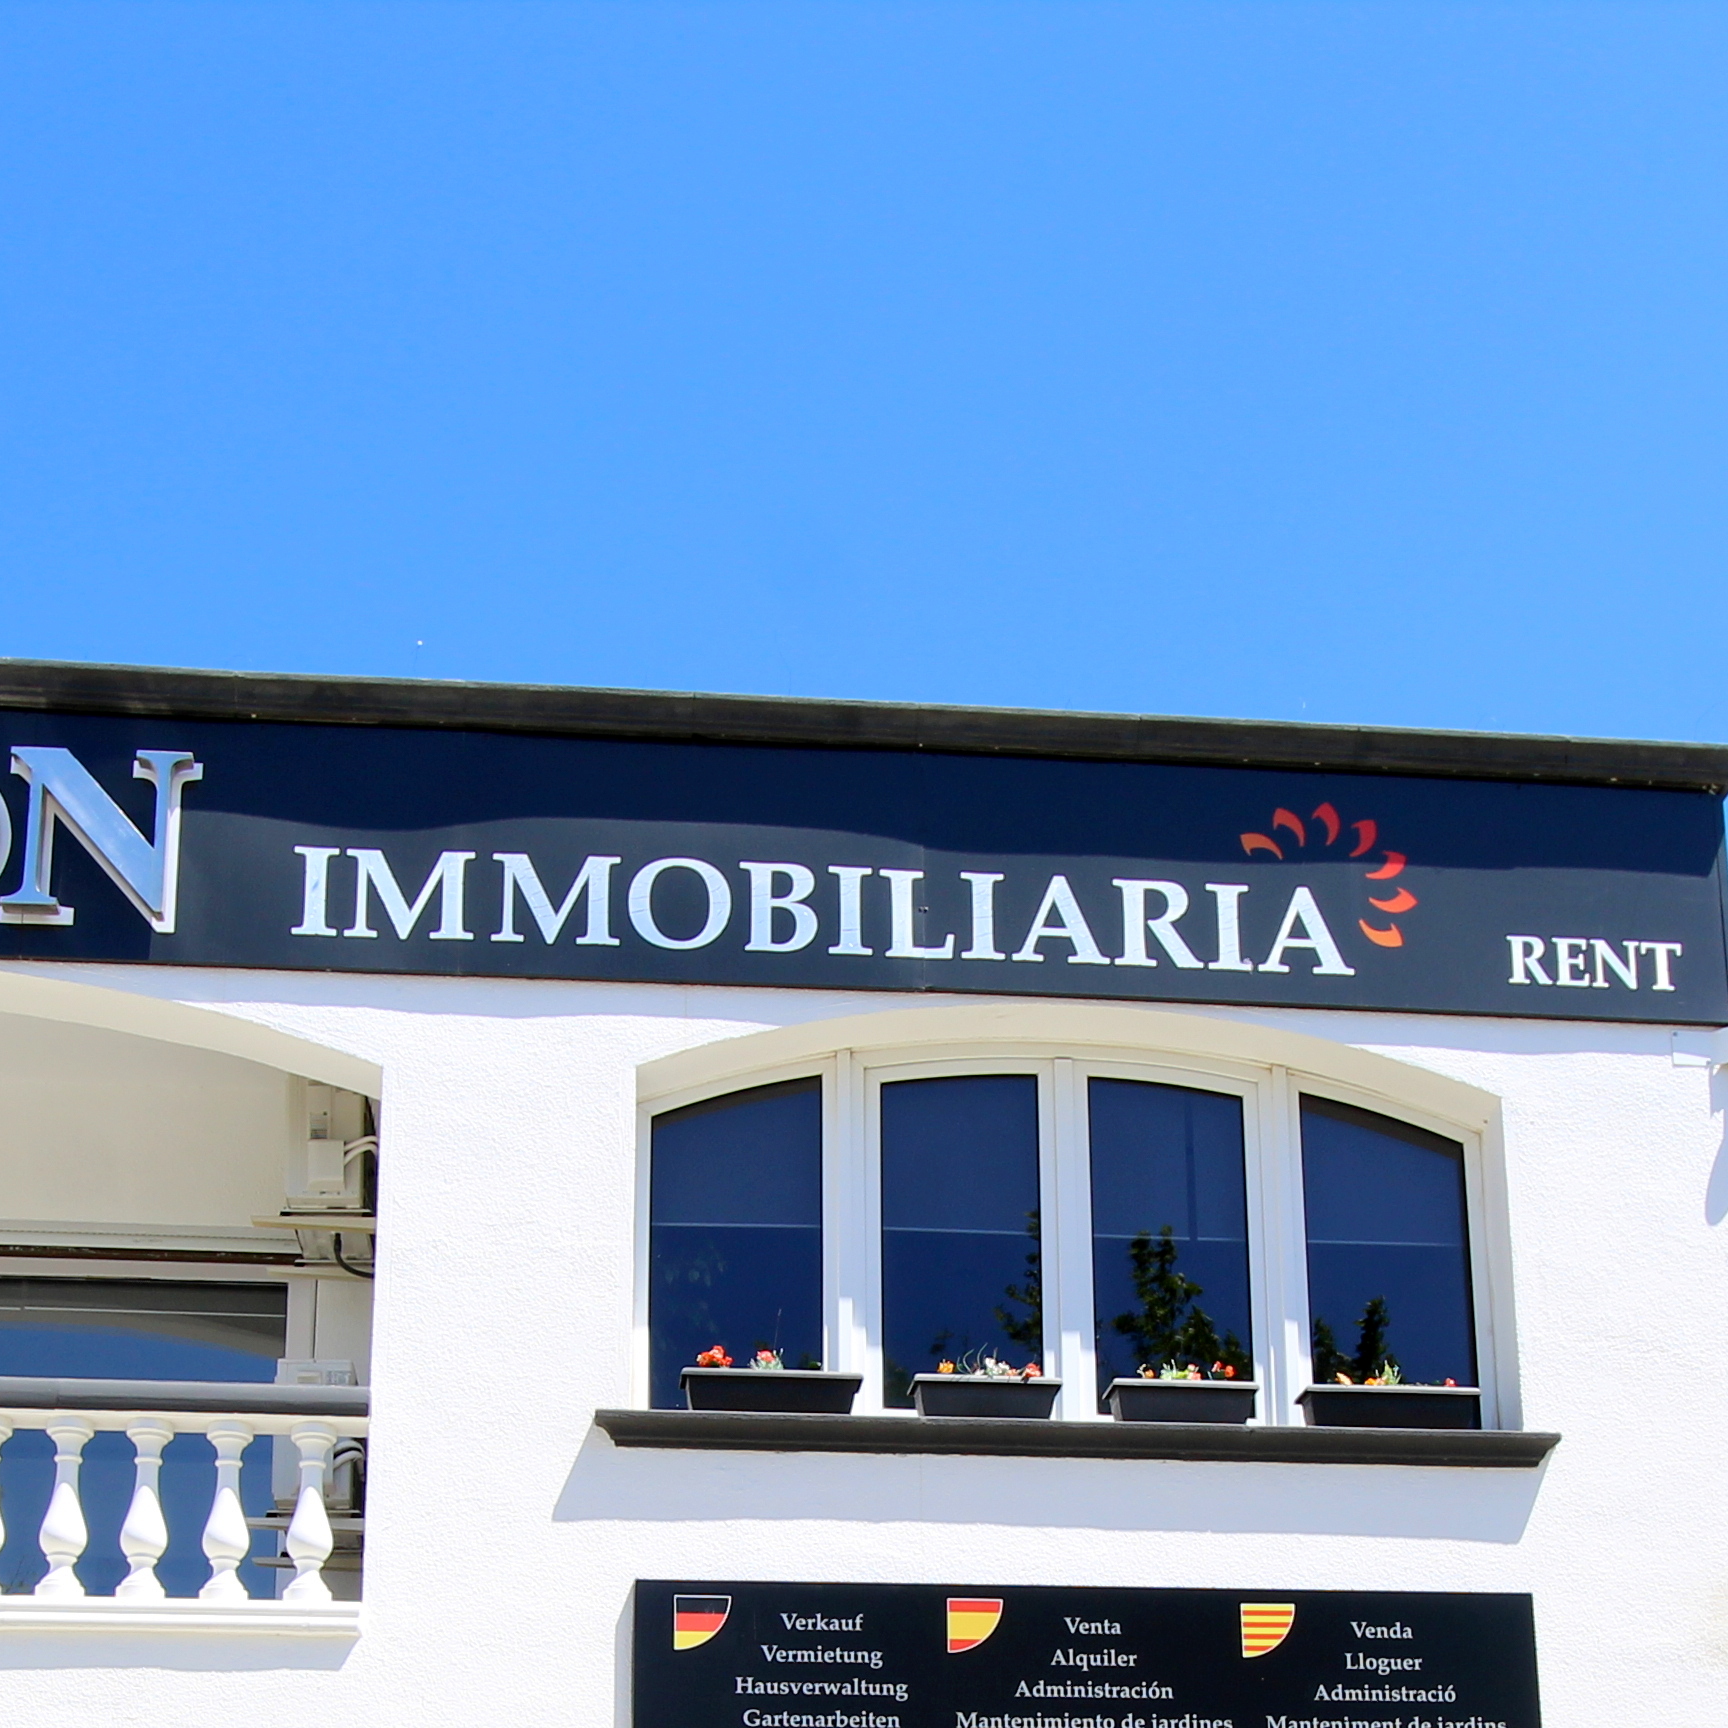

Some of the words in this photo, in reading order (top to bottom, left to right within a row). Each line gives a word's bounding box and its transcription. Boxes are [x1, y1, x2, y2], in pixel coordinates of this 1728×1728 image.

[291, 846, 1355, 975] IMMOBILIARIA
[1506, 936, 1681, 990] RENT
[780, 1613, 863, 1631] Verkauf
[1064, 1617, 1121, 1634] Venta
[1351, 1622, 1413, 1638] Venda
[761, 1645, 883, 1669] Vermietung
[1051, 1649, 1137, 1671] Alquiler
[1345, 1653, 1422, 1675] Lloguer
[736, 1677, 908, 1701] Hausverwaltung
[1015, 1680, 1173, 1699] Administración
[1314, 1684, 1456, 1702] Administració
[743, 1709, 900, 1728] Gartenarbeiten
